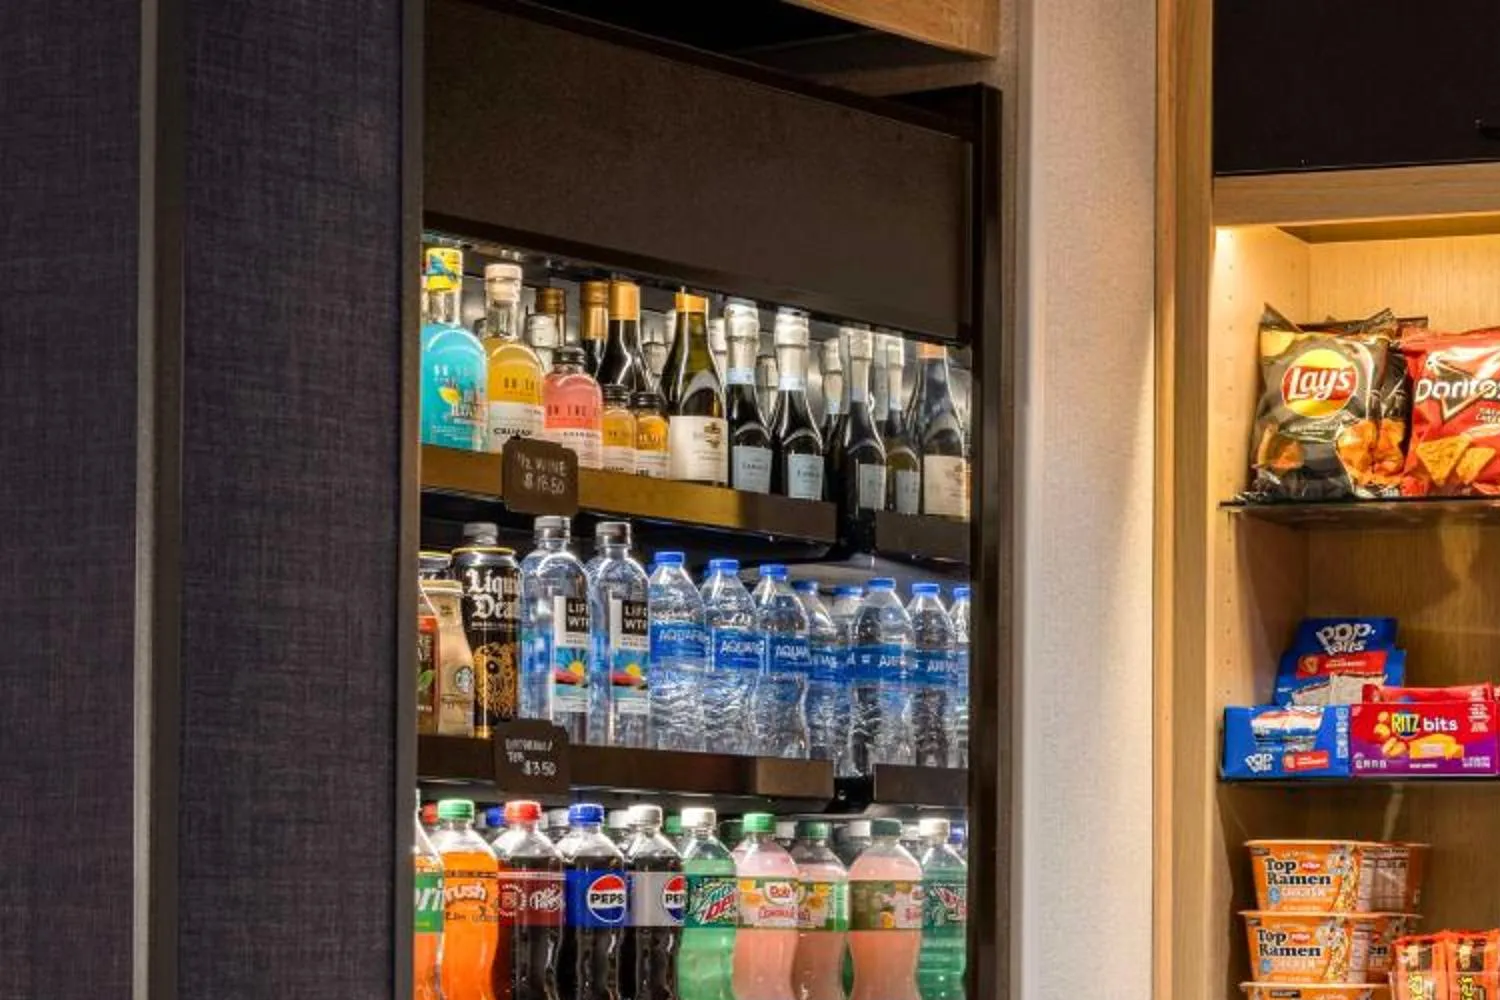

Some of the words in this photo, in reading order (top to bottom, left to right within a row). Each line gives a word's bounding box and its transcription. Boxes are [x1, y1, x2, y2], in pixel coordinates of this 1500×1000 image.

[1391, 712, 1420, 733] RITZ
[1423, 713, 1459, 732] bits
[1264, 857, 1297, 873] Top
[1266, 871, 1331, 885] Ramen
[1257, 929, 1287, 945] Top
[1258, 944, 1321, 957] Ramen
